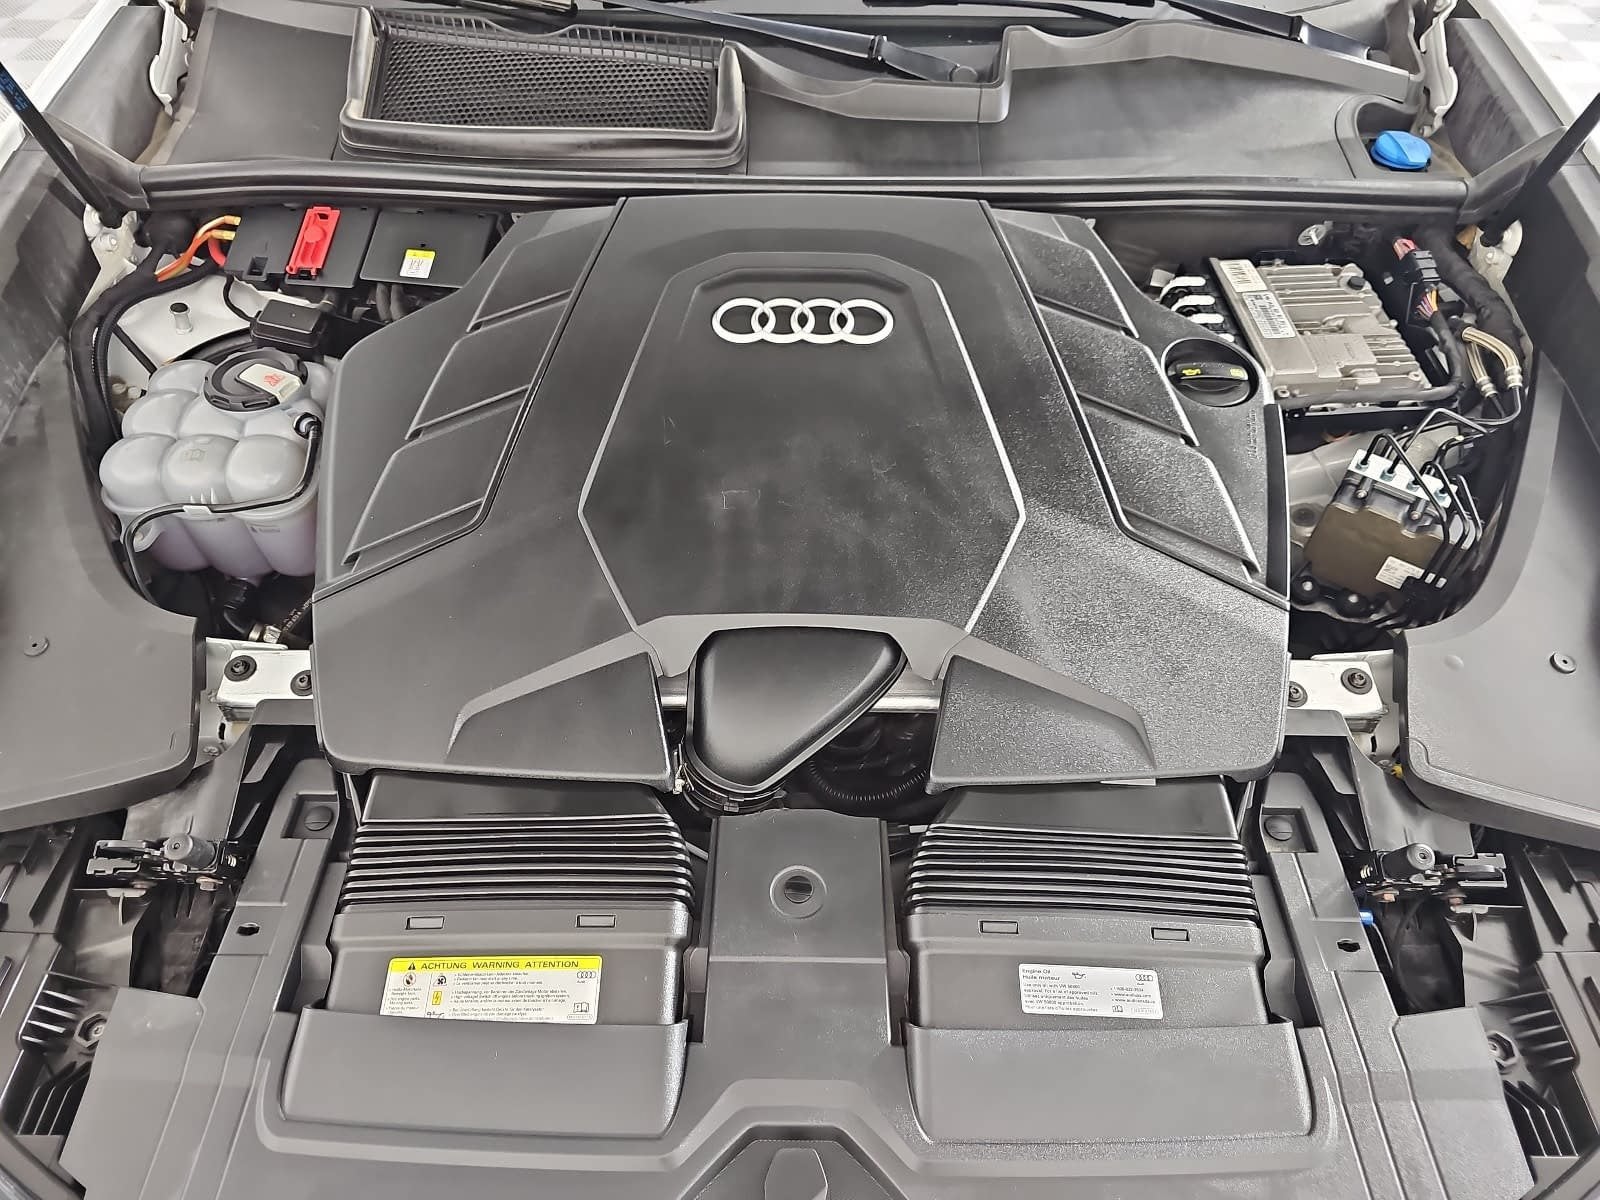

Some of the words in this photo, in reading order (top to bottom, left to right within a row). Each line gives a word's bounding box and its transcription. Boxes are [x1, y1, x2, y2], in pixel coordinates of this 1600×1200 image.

[421, 962, 467, 970] ACHTUNG
[472, 961, 520, 969] WARNING
[525, 960, 579, 968] ATTENTION
